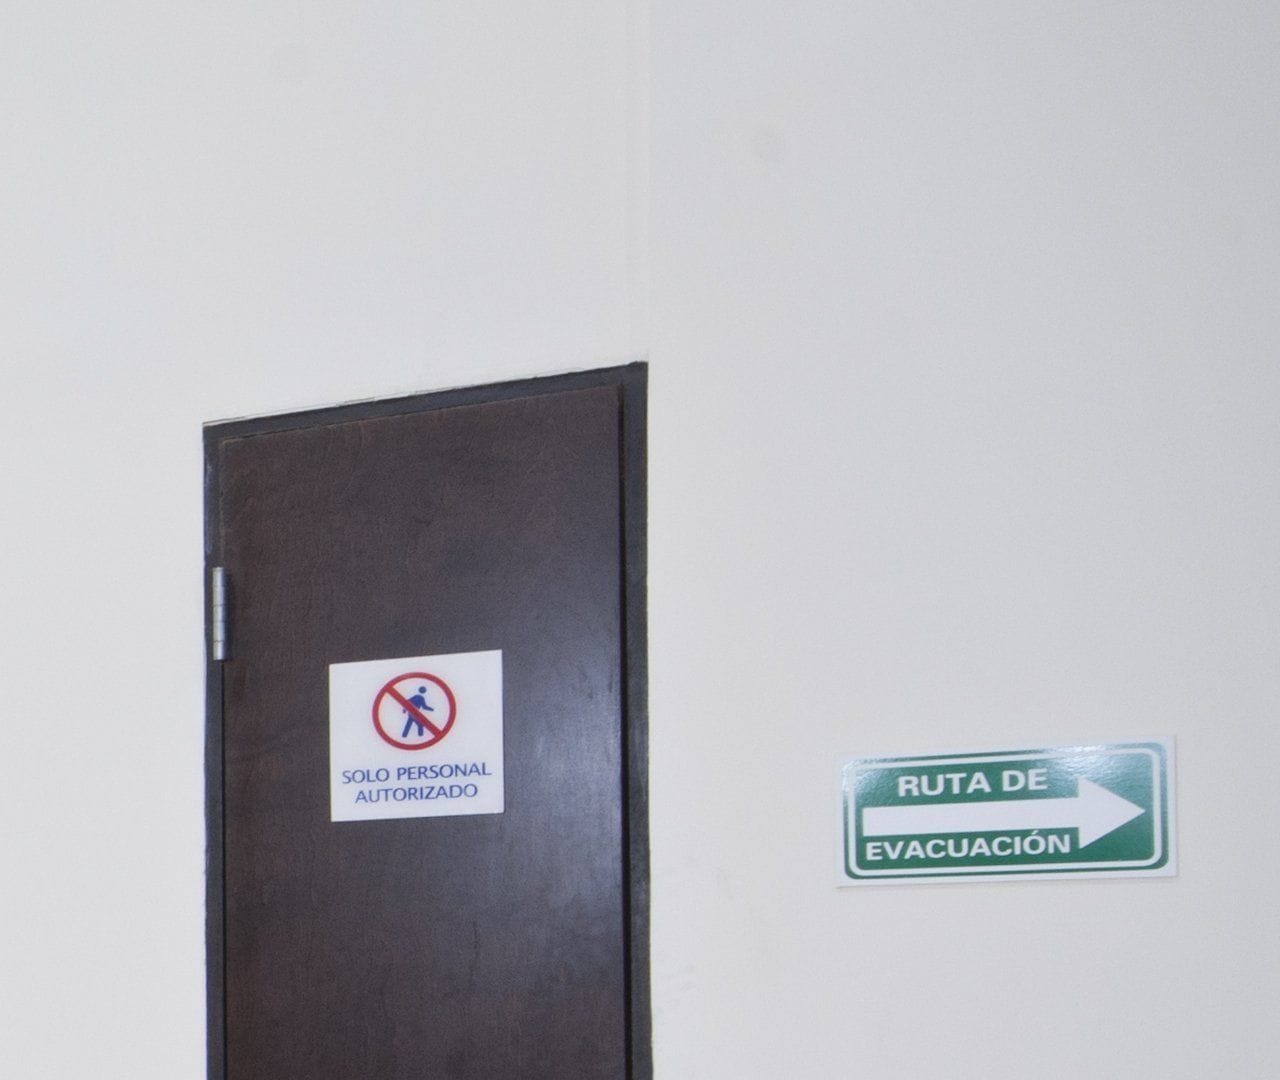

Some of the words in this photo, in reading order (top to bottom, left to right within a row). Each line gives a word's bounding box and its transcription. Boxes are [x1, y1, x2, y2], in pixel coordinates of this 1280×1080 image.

[342, 767, 390, 785] SOLO
[396, 762, 492, 781] PERSONAL
[897, 771, 992, 798] RUTA
[1001, 768, 1049, 792] DE
[354, 783, 478, 804] AUTORIZADO
[865, 830, 1072, 861] EVACUACIÓN
